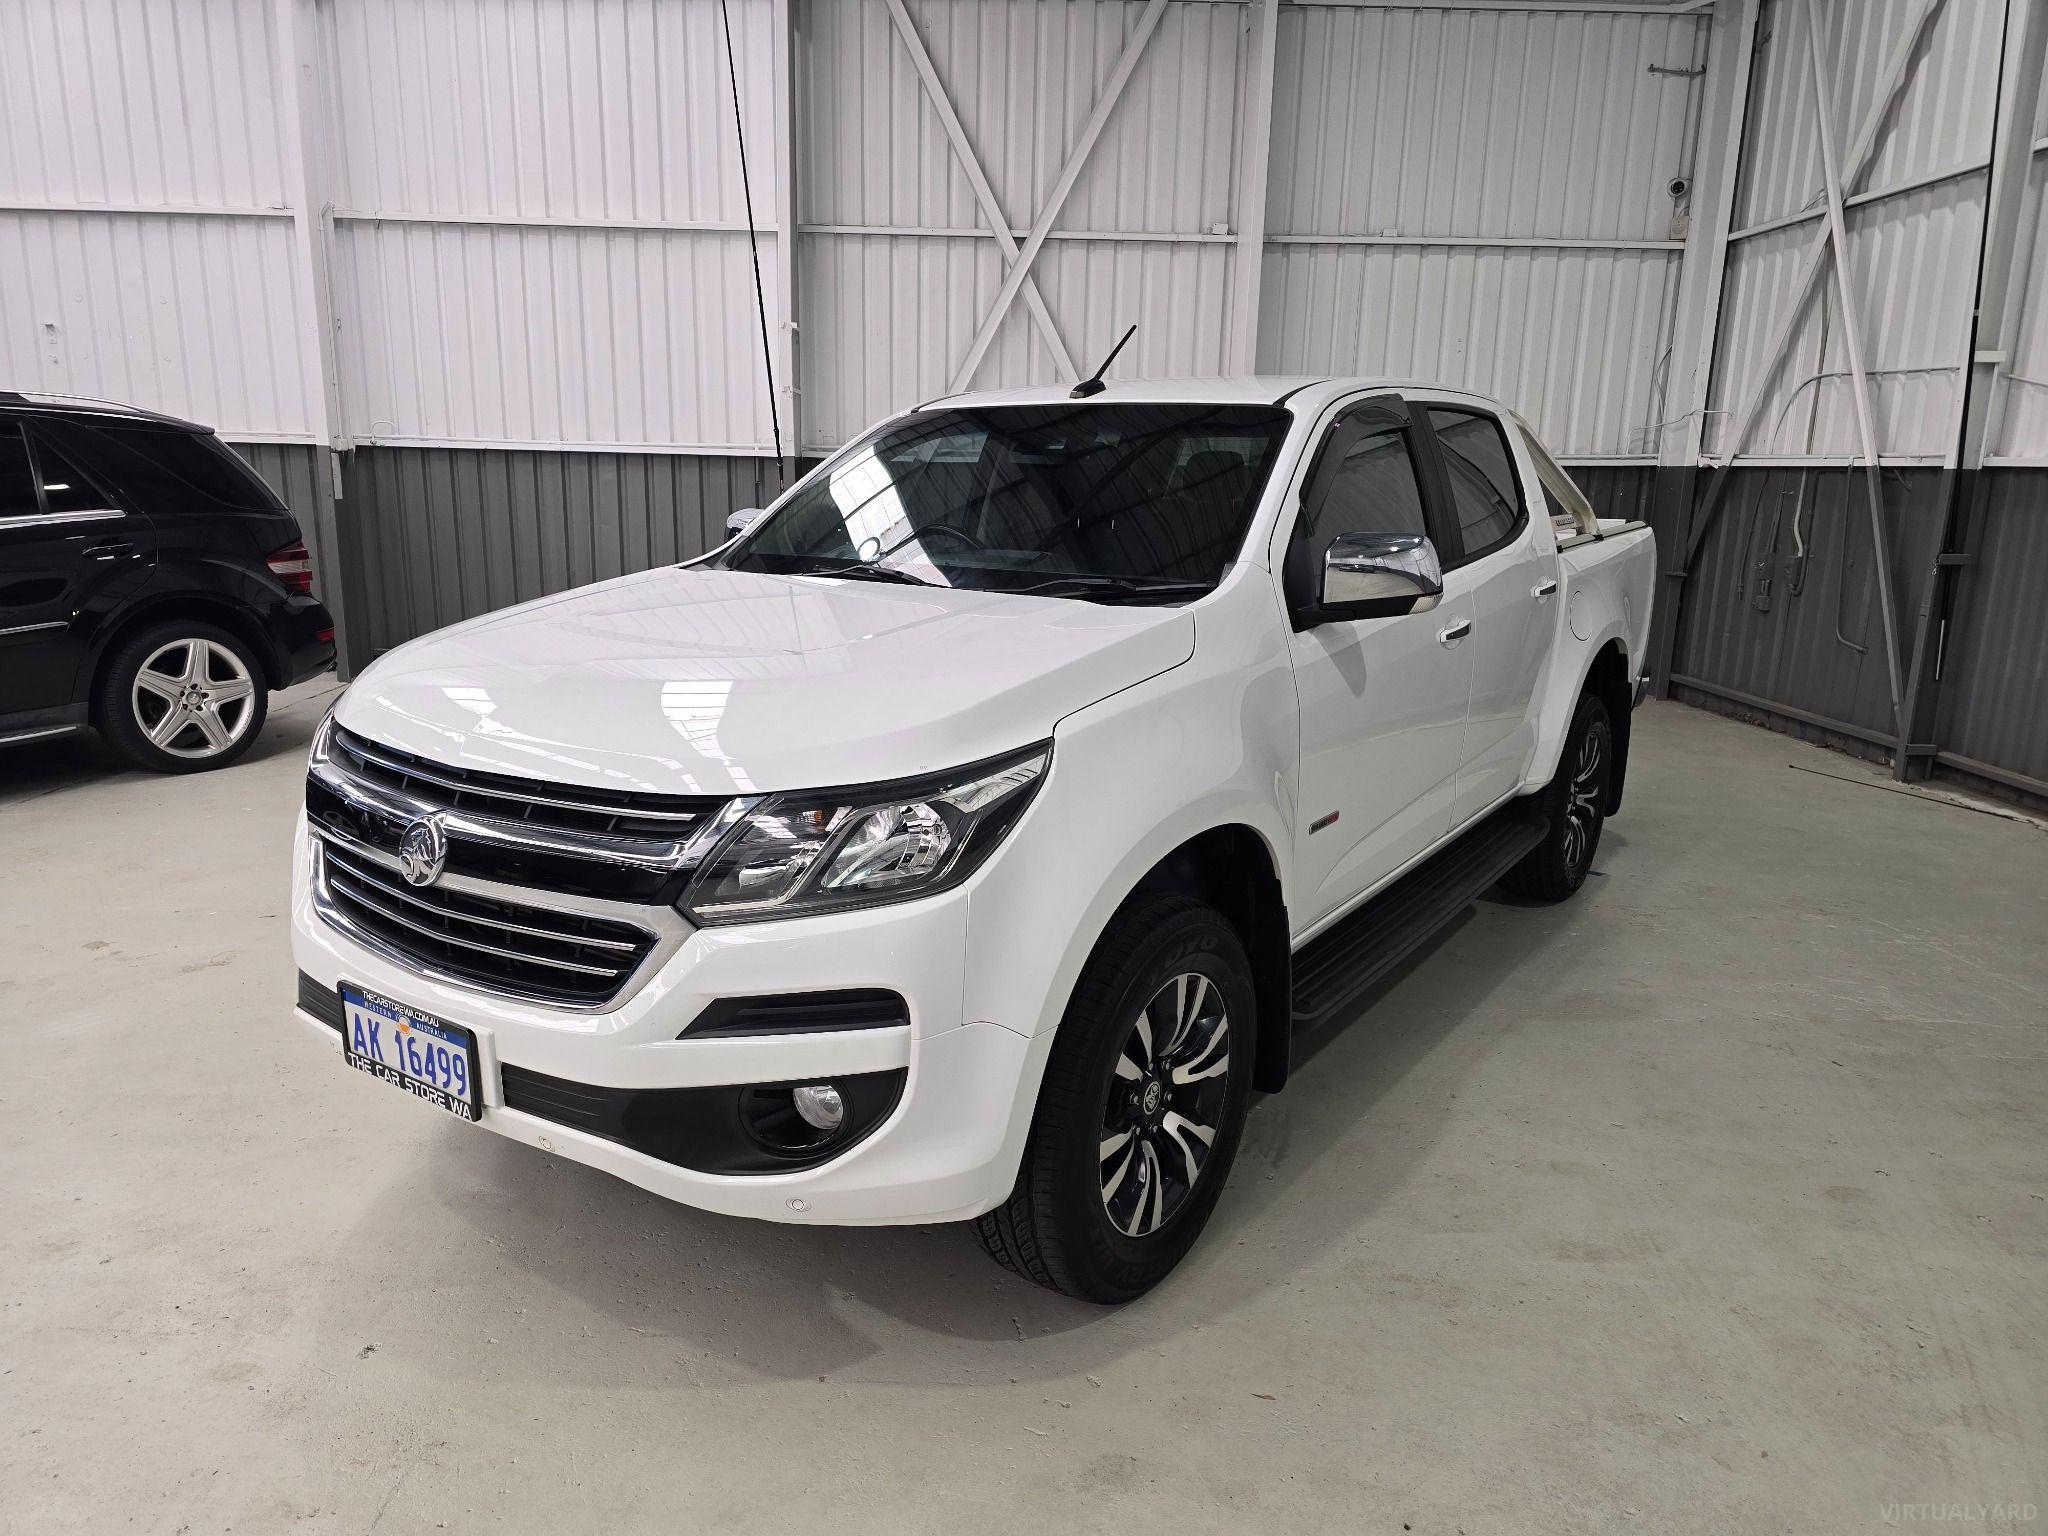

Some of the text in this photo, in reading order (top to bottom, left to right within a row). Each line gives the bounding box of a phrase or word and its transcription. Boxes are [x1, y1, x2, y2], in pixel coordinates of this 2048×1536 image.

[353, 1012, 467, 1096] AK 16499
[364, 1002, 448, 1040] WESTERN AUSTRALIA
[347, 1052, 472, 1121] THE CAR STORE WA
